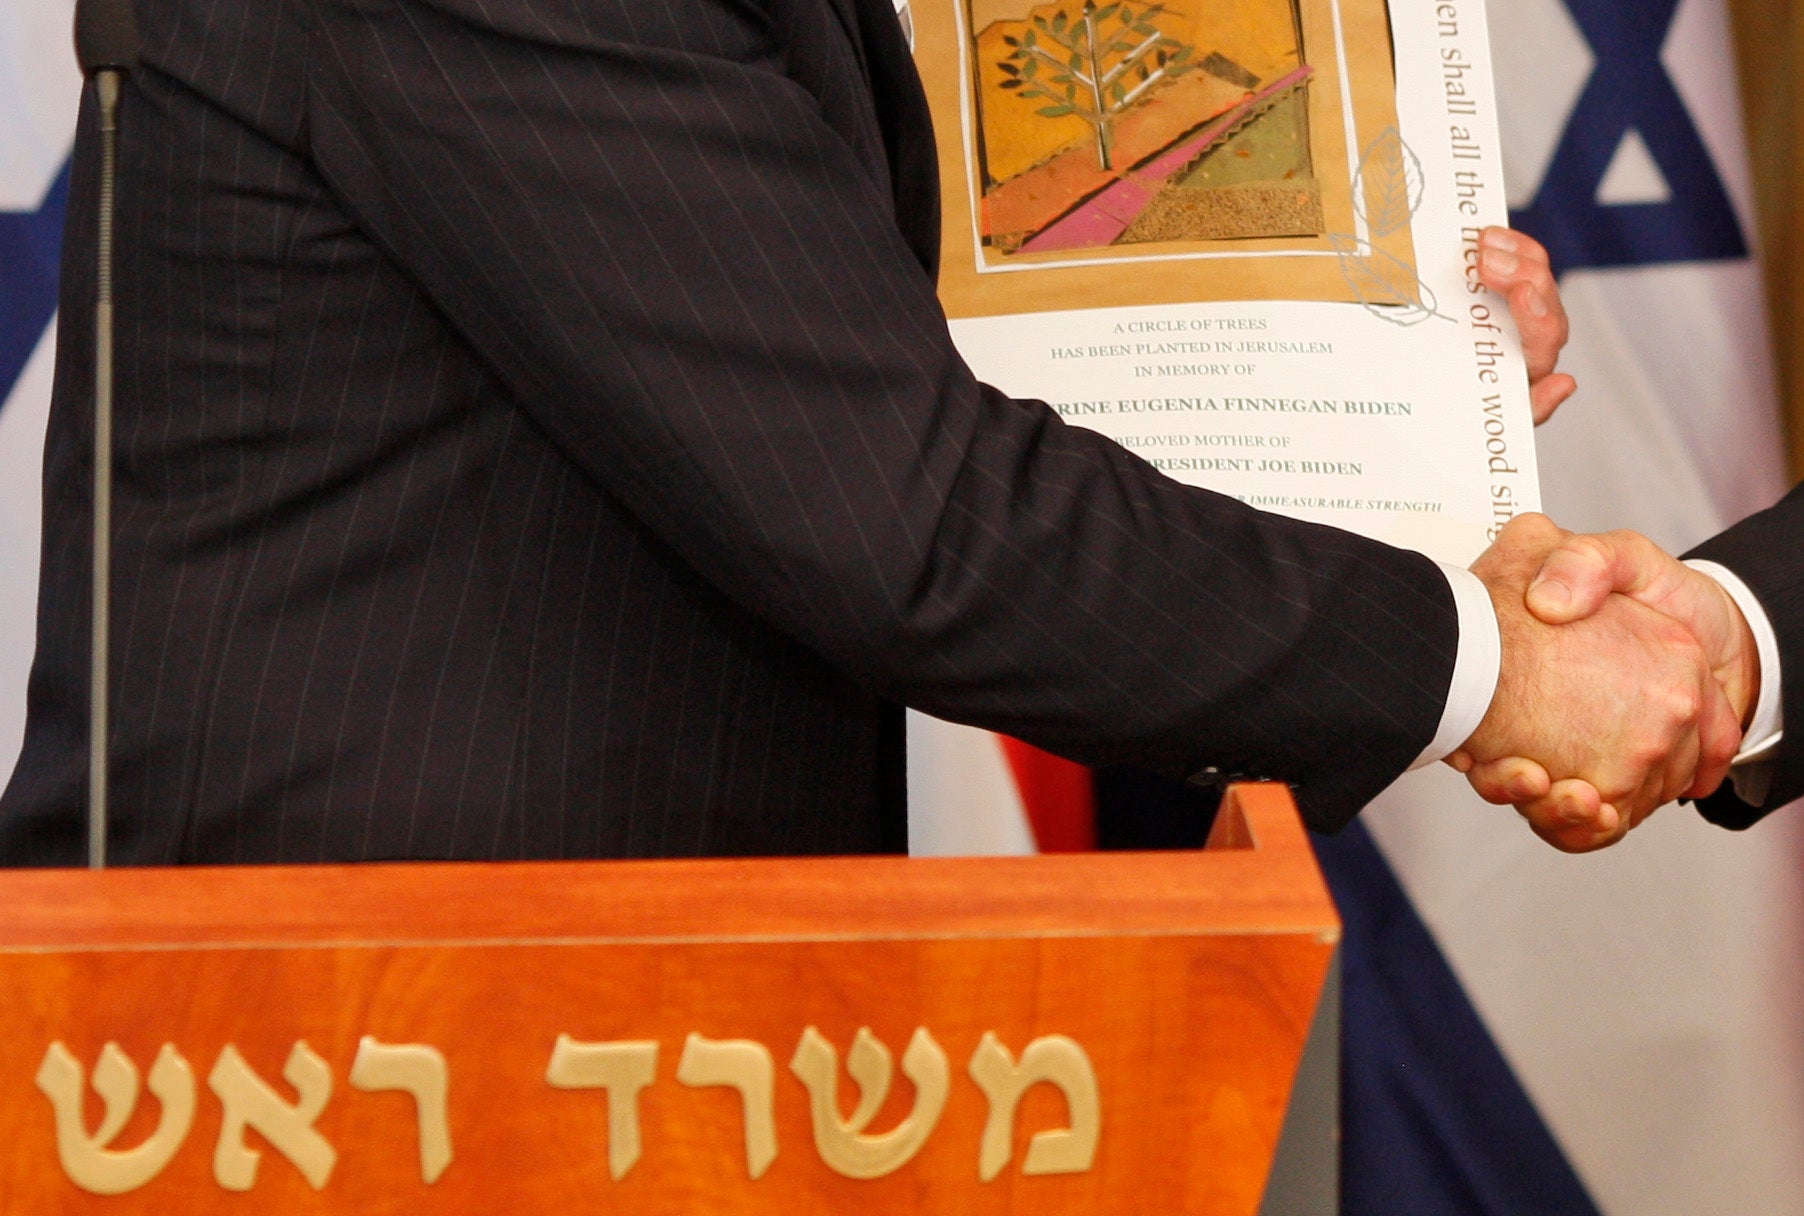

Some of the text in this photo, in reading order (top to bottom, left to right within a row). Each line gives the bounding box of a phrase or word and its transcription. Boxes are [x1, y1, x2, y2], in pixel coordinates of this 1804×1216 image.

[1441, 48, 1477, 115] shall
[1450, 125, 1481, 159] all
[1455, 170, 1484, 215] the
[1113, 318, 1267, 333] A CIRCLE OF TREES
[1470, 303, 1501, 333] of
[1051, 341, 1333, 359] HAS BEEN PLANTED IN JERUSALEM
[1134, 363, 1256, 377] IN MEMORY OF
[1475, 344, 1505, 384] the
[1052, 398, 1412, 416] RINE EUGENIA FINNEGAN BIDEN
[1194, 434, 1266, 447] MOTHER
[1269, 435, 1291, 447] OF
[1482, 393, 1518, 474] wood
[1146, 457, 1363, 475] RESIDENT JOE BIDEN
[1249, 494, 1363, 510] IMMEASURABLE
[1366, 498, 1442, 513] STRENGTH
[34, 1026, 1101, 1196] משרד ראש
